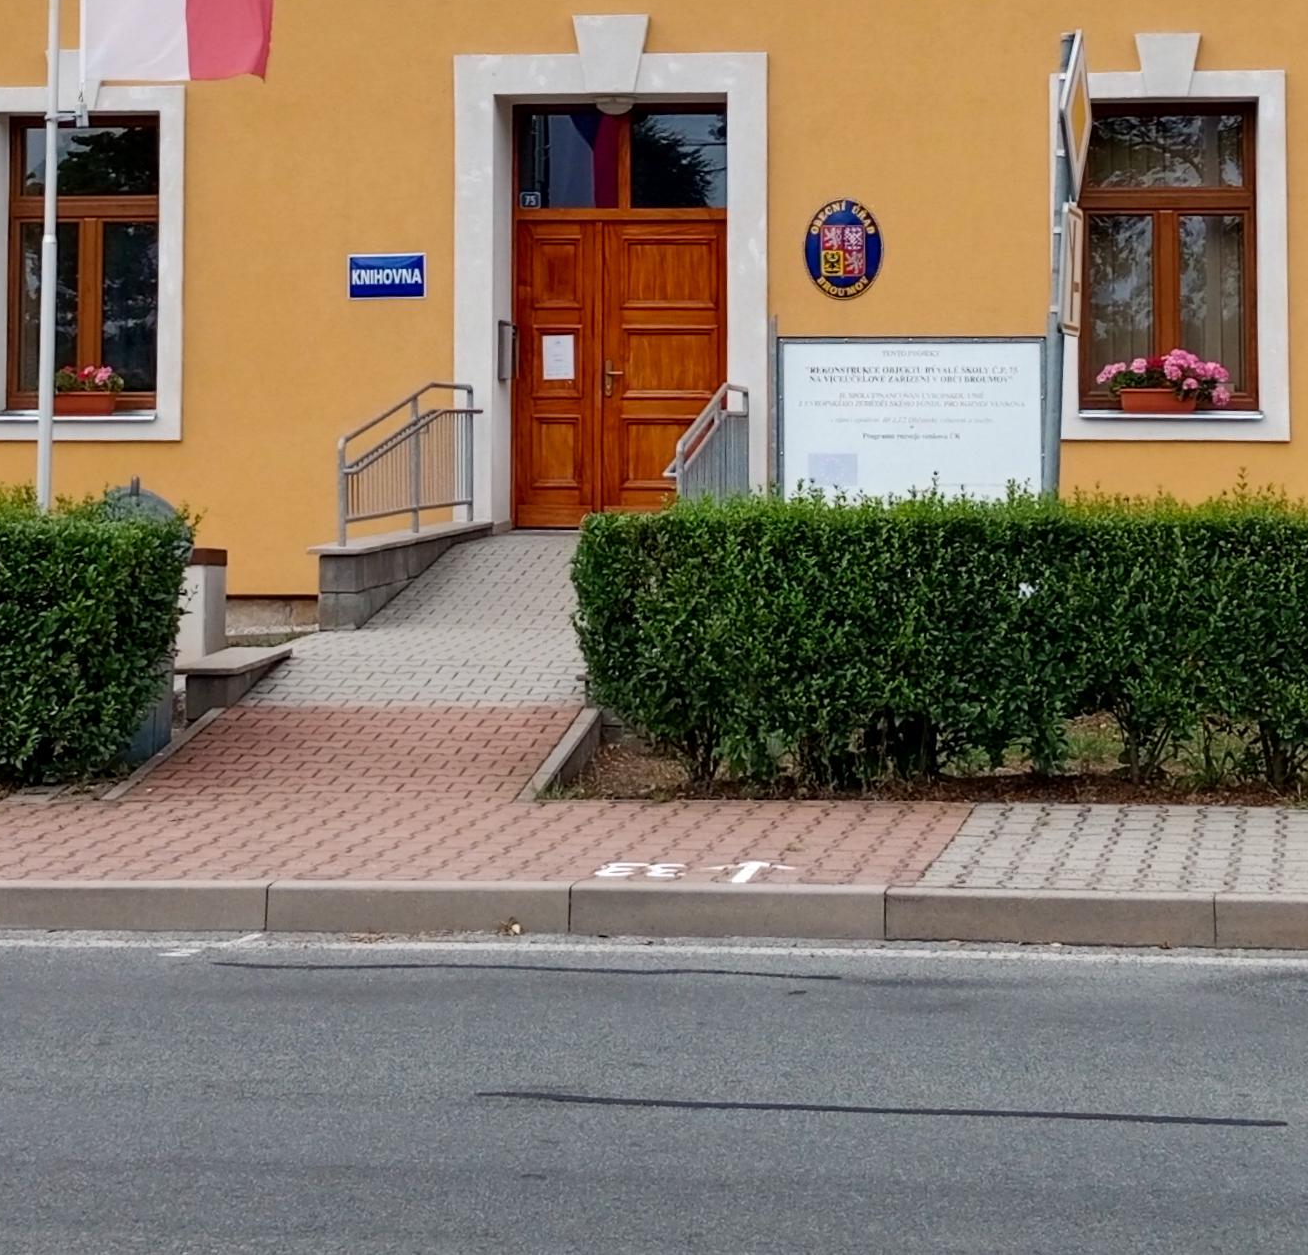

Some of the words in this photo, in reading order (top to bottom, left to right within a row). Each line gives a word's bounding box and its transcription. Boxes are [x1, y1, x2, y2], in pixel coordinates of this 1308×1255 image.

[524, 195, 537, 206] 75
[810, 201, 847, 235] OBECNÍ
[351, 268, 423, 286] KNIHOVNA
[816, 275, 869, 297] BROUMOV
